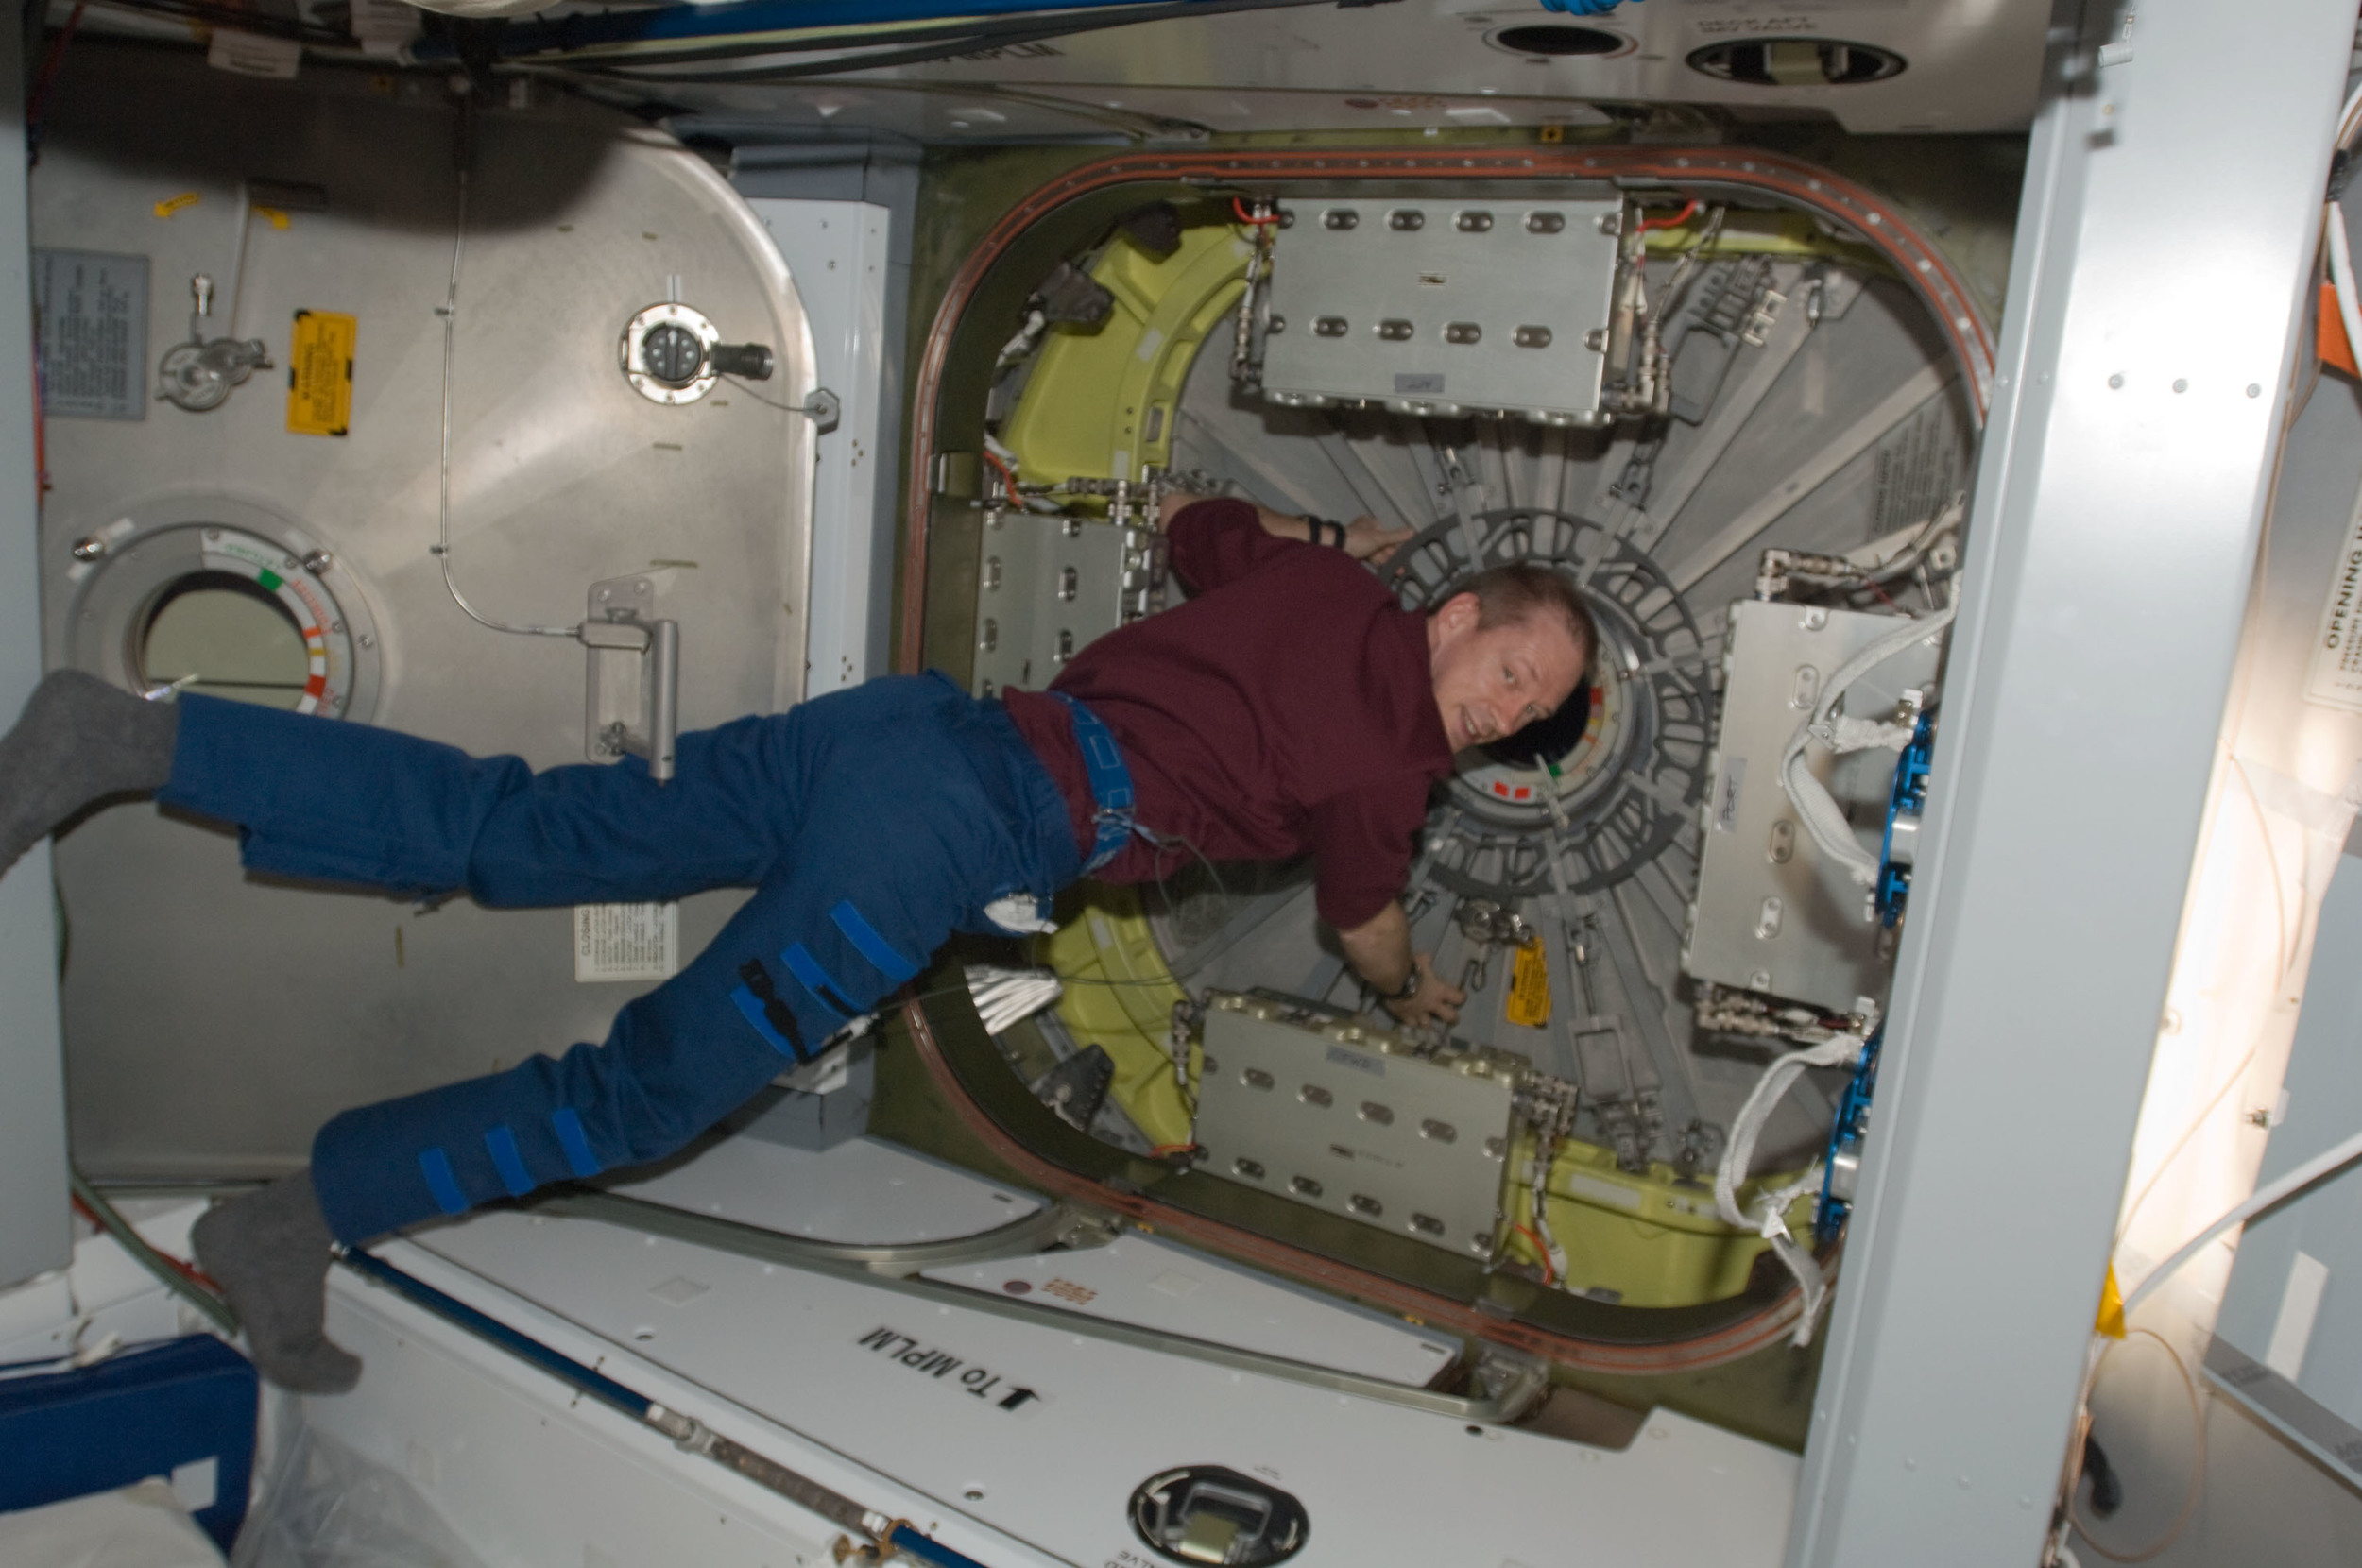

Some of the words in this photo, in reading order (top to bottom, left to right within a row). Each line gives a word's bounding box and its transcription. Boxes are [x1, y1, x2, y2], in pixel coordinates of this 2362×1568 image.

[2327, 550, 2362, 650] OPENING
[580, 909, 590, 956] CLOSING
[857, 1326, 964, 1379] MPLM
[959, 1367, 1002, 1400] To
